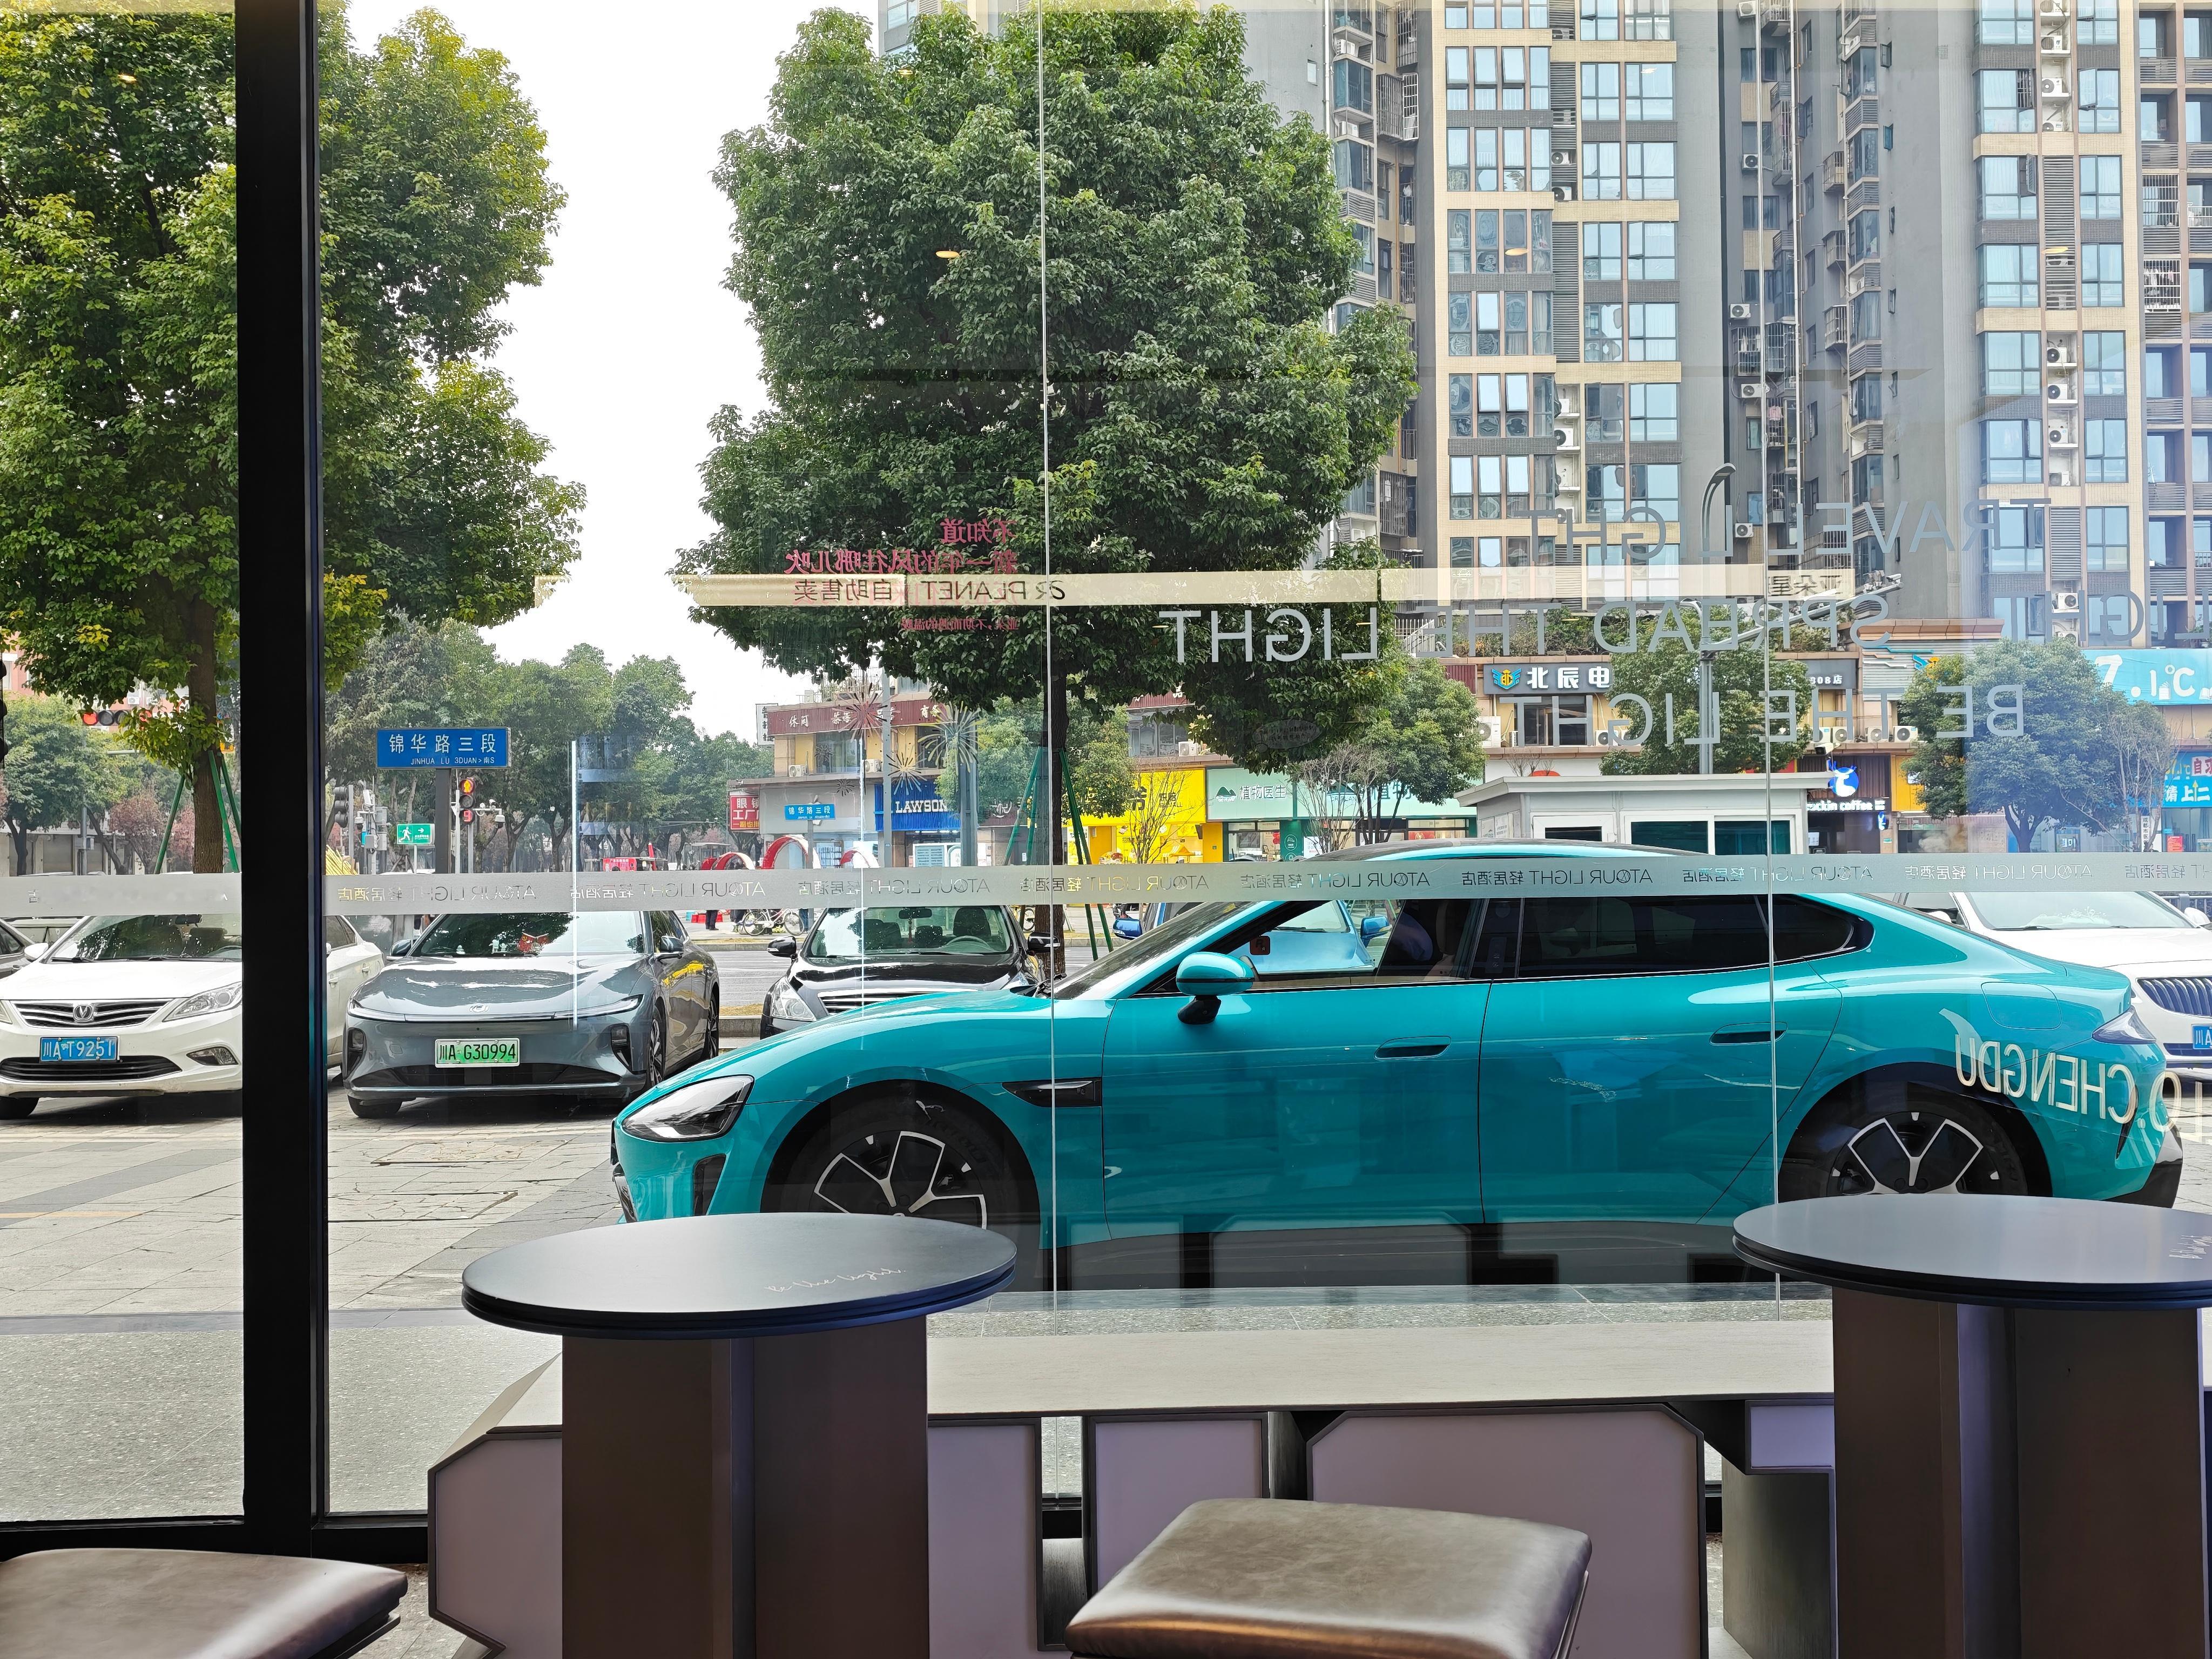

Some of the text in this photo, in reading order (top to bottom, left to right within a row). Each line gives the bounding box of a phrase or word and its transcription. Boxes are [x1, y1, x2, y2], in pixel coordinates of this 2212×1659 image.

[1527, 666, 1610, 689] 北辰电
[389, 733, 497, 755] 锦华路三段
[1239, 785, 1287, 800] 植物医生
[788, 805, 831, 815] 锦华路三段
[895, 799, 949, 813] LAWSON
[1806, 800, 1837, 811] uckin
[1839, 800, 1873, 811] coffee
[733, 810, 759, 820] 工厂
